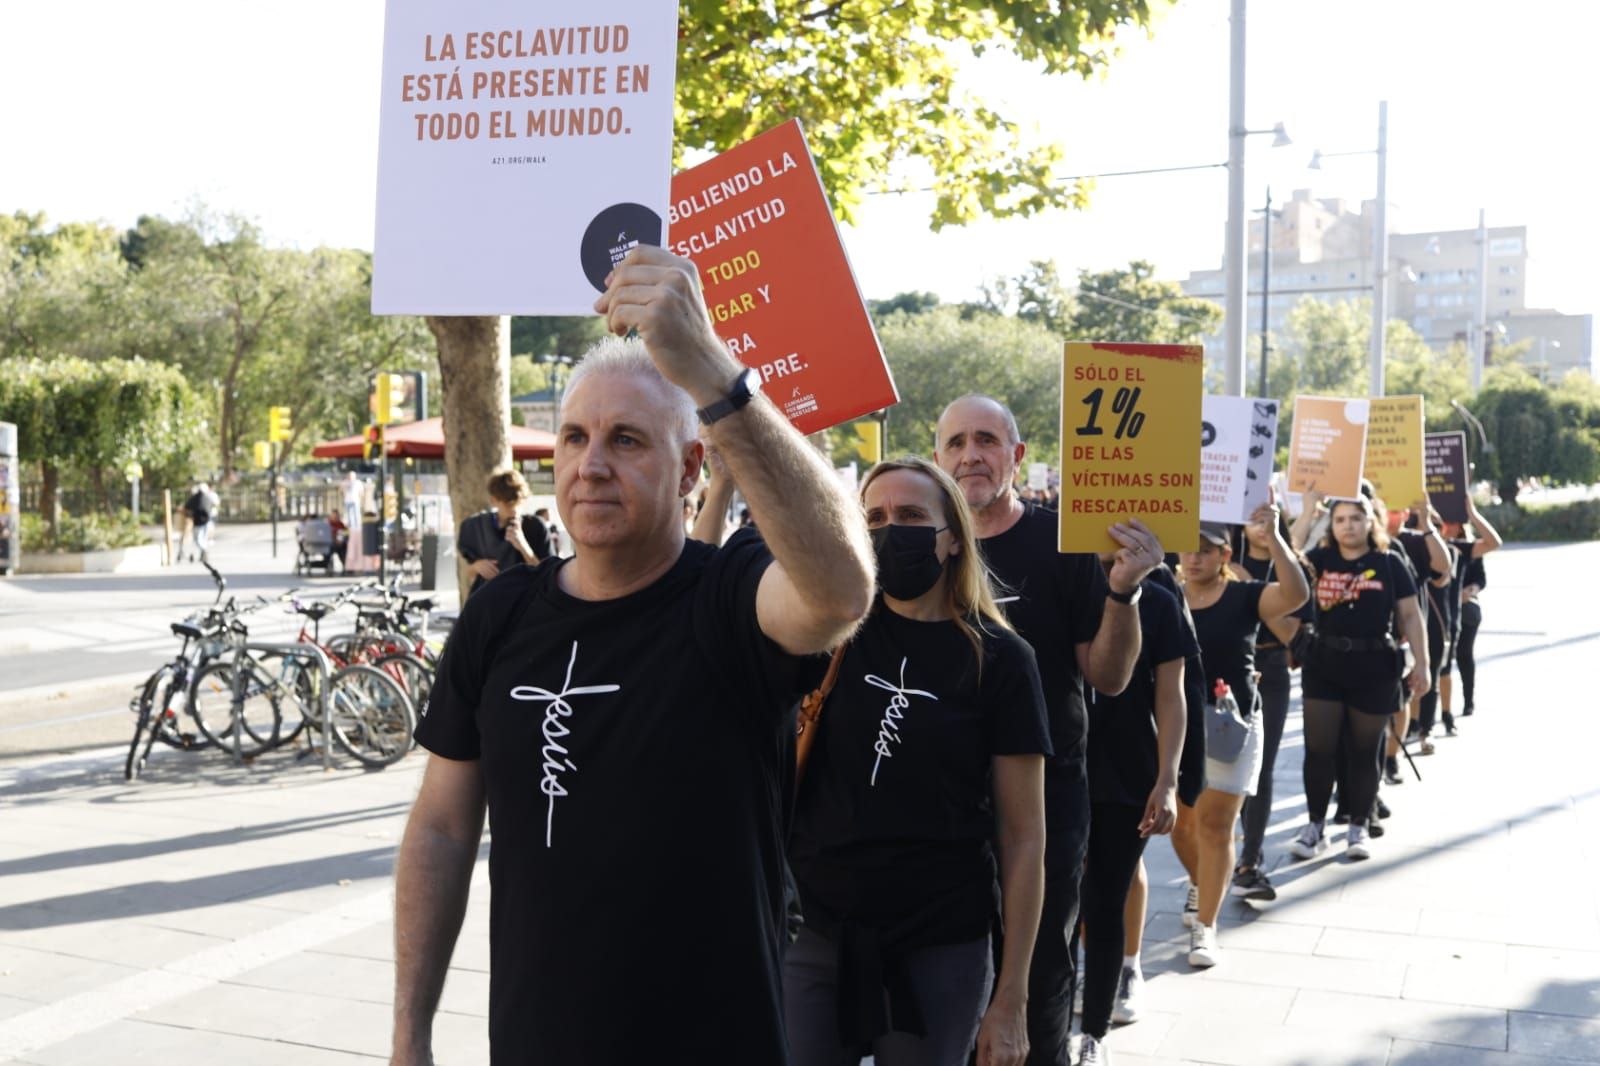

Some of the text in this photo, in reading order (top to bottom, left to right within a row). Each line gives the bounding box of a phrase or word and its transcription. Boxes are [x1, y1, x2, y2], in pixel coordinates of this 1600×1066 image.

[425, 25, 630, 62] LA ESCLAVITUD
[402, 64, 650, 102] ESTÁ PRESENTE EN
[415, 106, 631, 141] TODO EL MUNDO.
[667, 152, 797, 225] BOLIENDO LA
[608, 243, 628, 255] WALK
[611, 253, 625, 262] FOR
[706, 250, 761, 286] TODO
[757, 284, 771, 304] Y
[727, 333, 757, 358] RA
[758, 353, 809, 383] PRE.
[1074, 363, 1145, 382] SÓLO EL
[1075, 386, 1146, 440] 1%
[1072, 446, 1134, 461] DE LAS
[1071, 469, 1194, 487] VÍCTIMAS SON
[1071, 499, 1189, 513] RESCATADAS.
